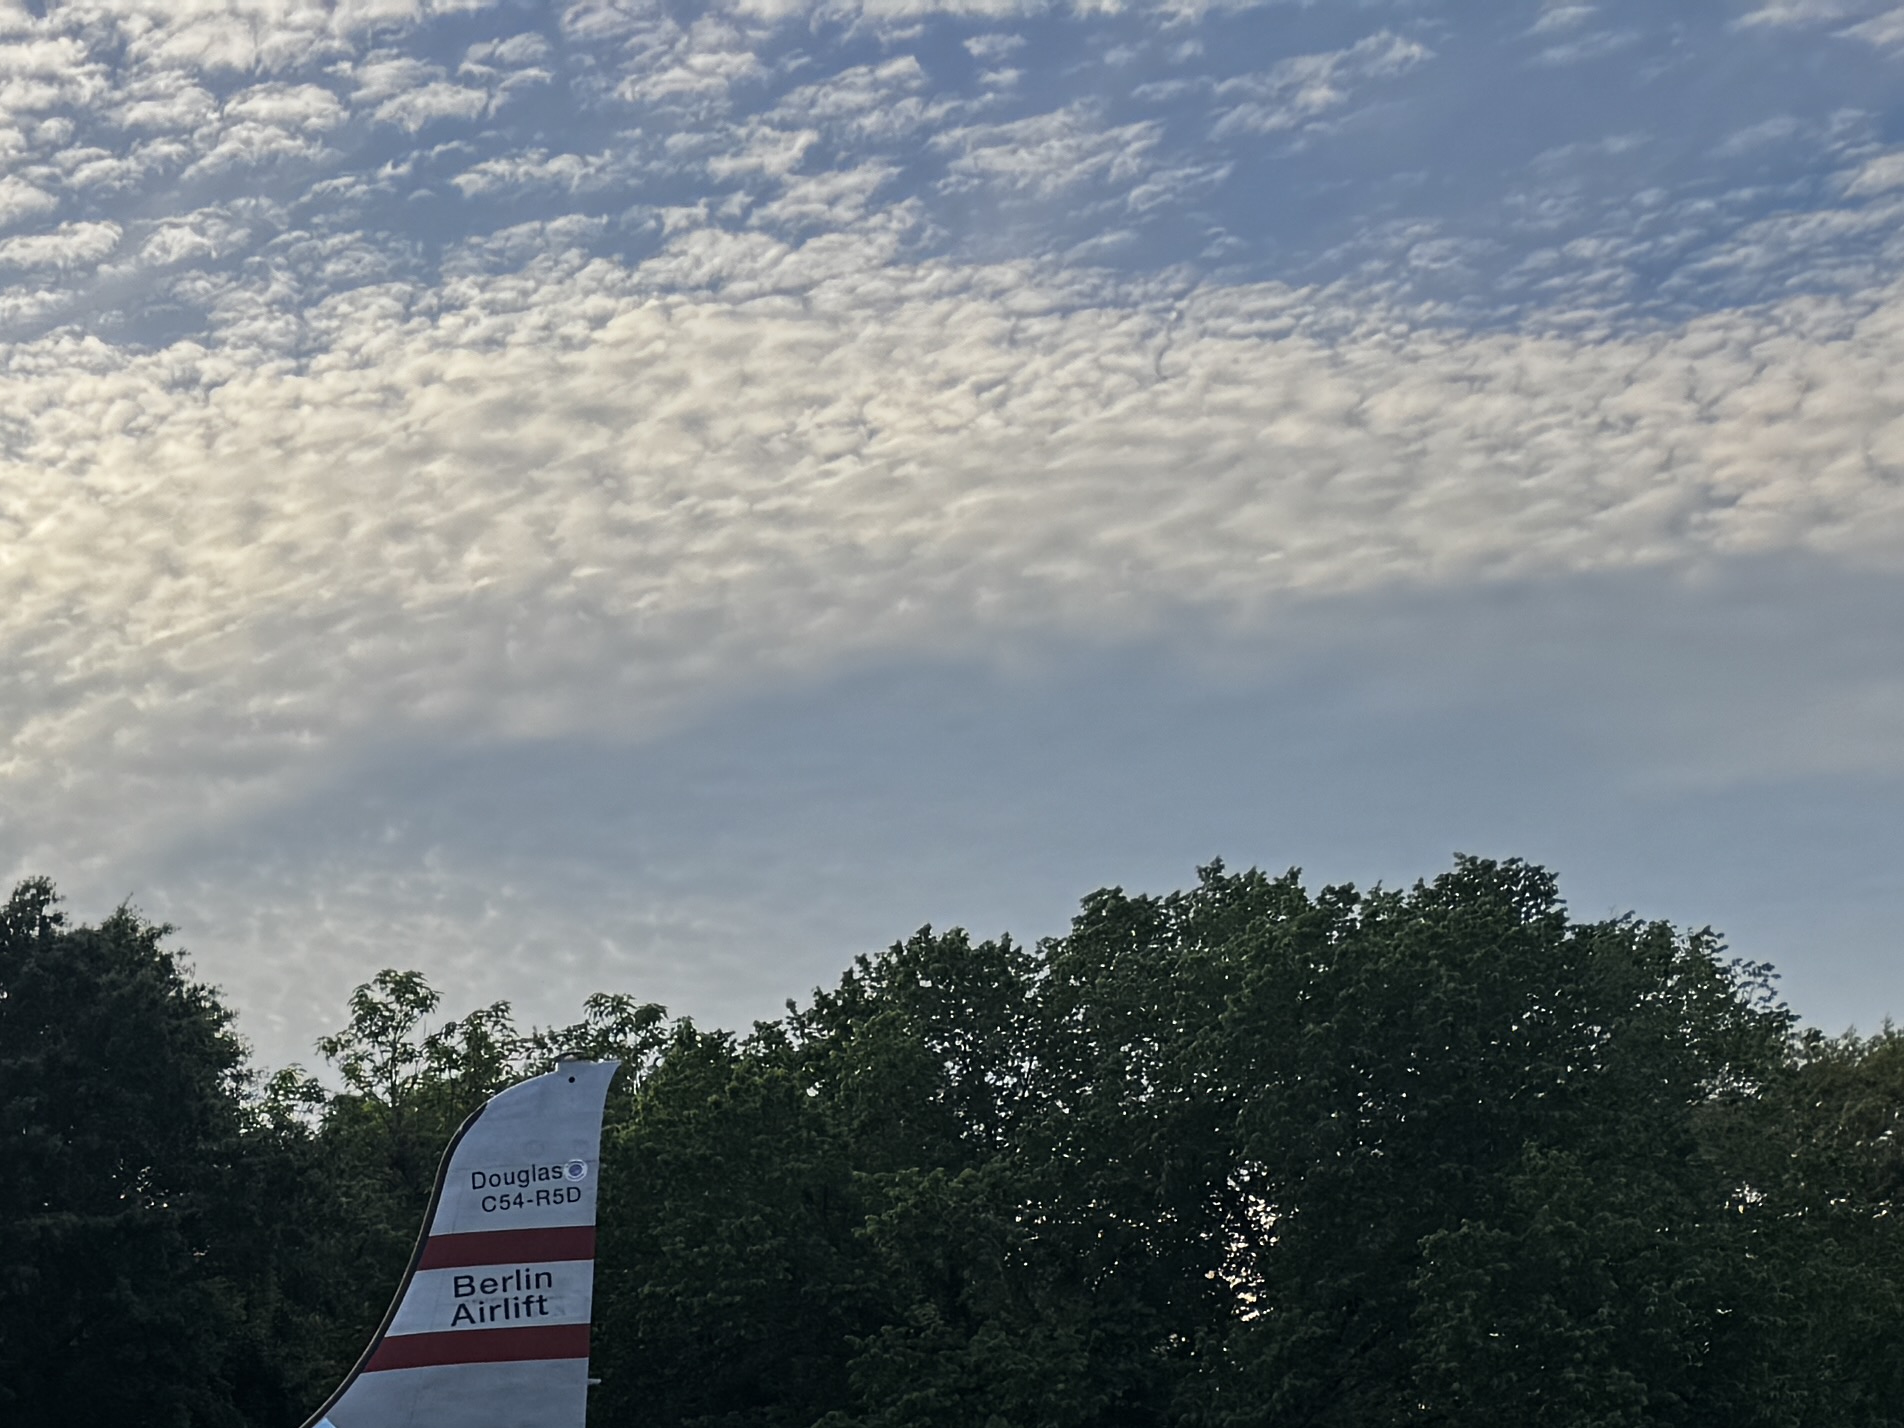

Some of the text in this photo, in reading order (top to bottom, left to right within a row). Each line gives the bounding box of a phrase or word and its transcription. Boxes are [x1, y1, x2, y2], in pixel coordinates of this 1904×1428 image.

[471, 1164, 564, 1190] Douglas
[481, 1186, 582, 1213] C54-R5D
[453, 1267, 553, 1299] Berlin
[450, 1294, 549, 1327] Airlift
